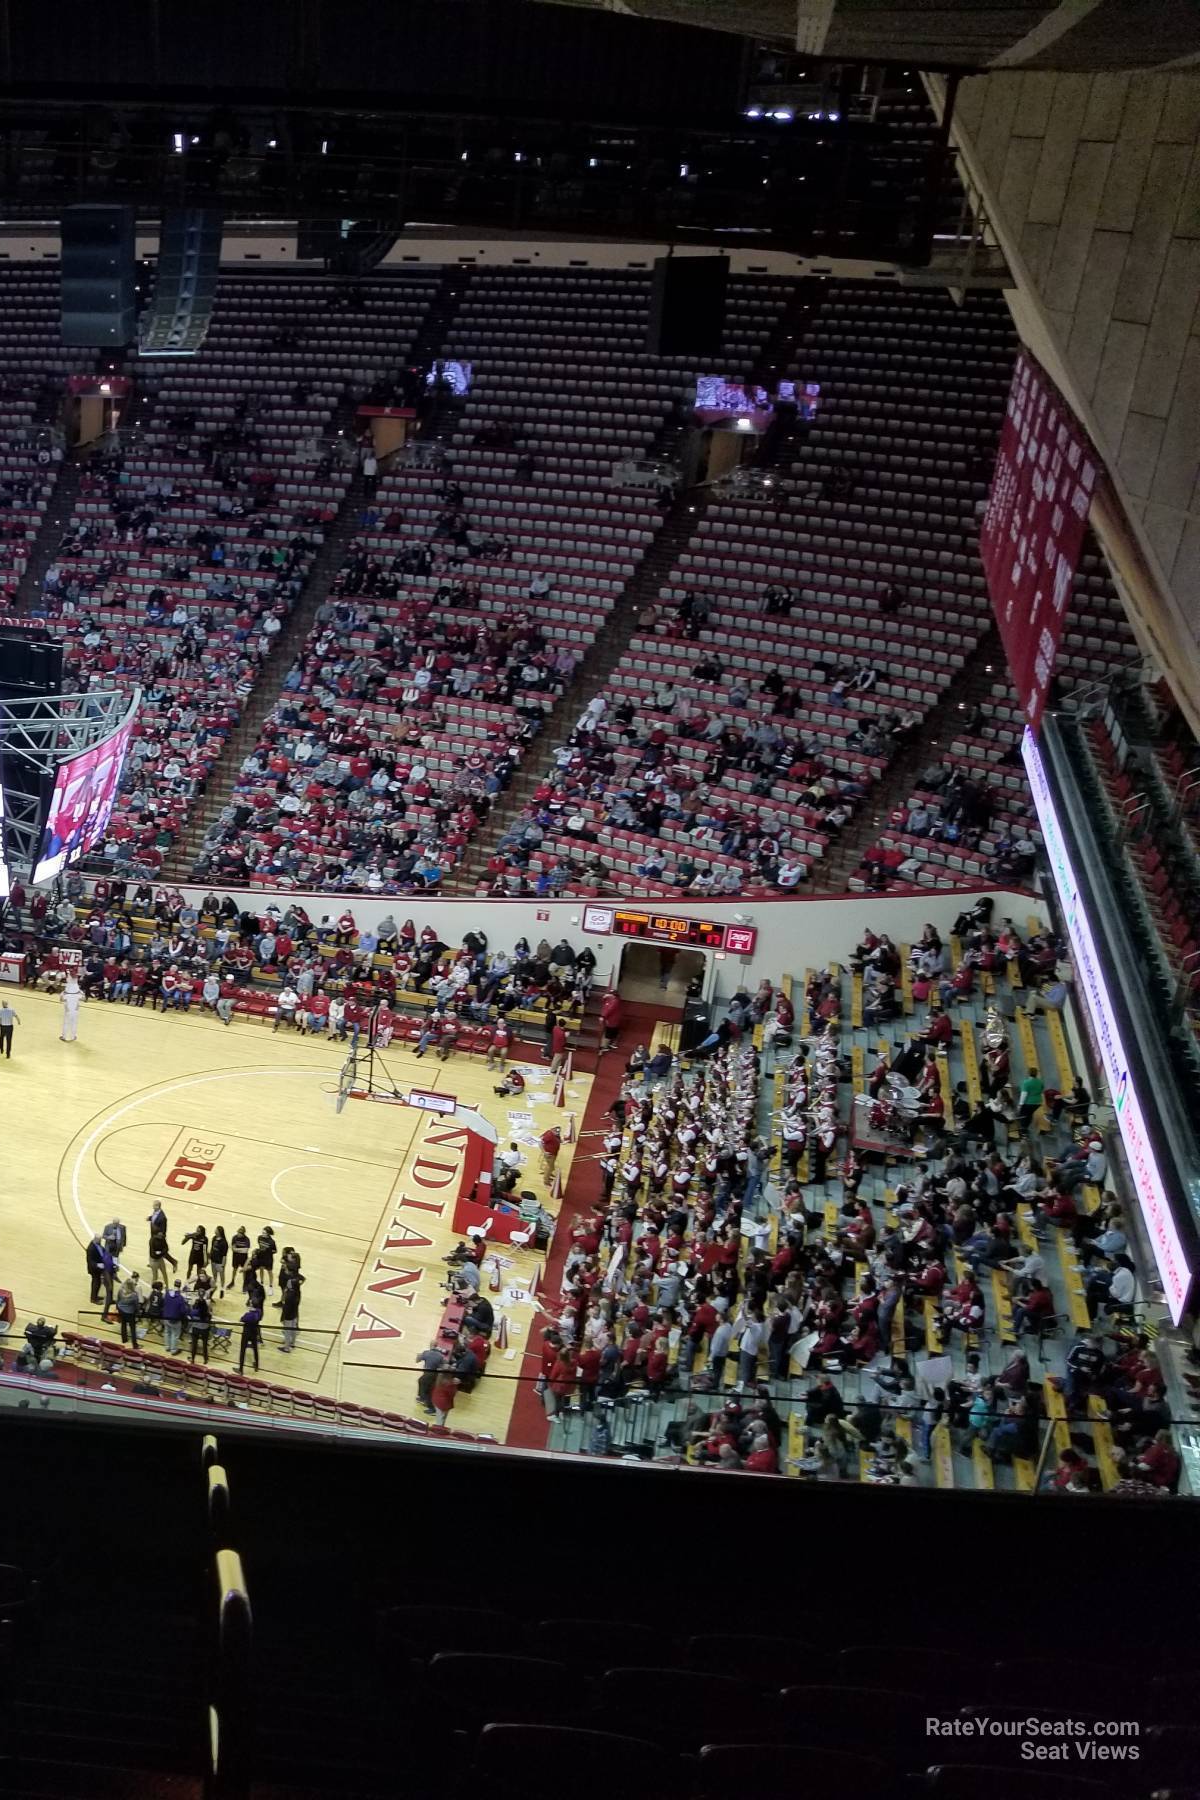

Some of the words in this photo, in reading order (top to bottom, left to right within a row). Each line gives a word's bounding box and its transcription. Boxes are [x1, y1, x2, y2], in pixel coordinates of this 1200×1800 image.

[655, 918, 686, 932] 10:00
[62, 951, 81, 963] WE
[347, 1103, 481, 1344] NDIANA
